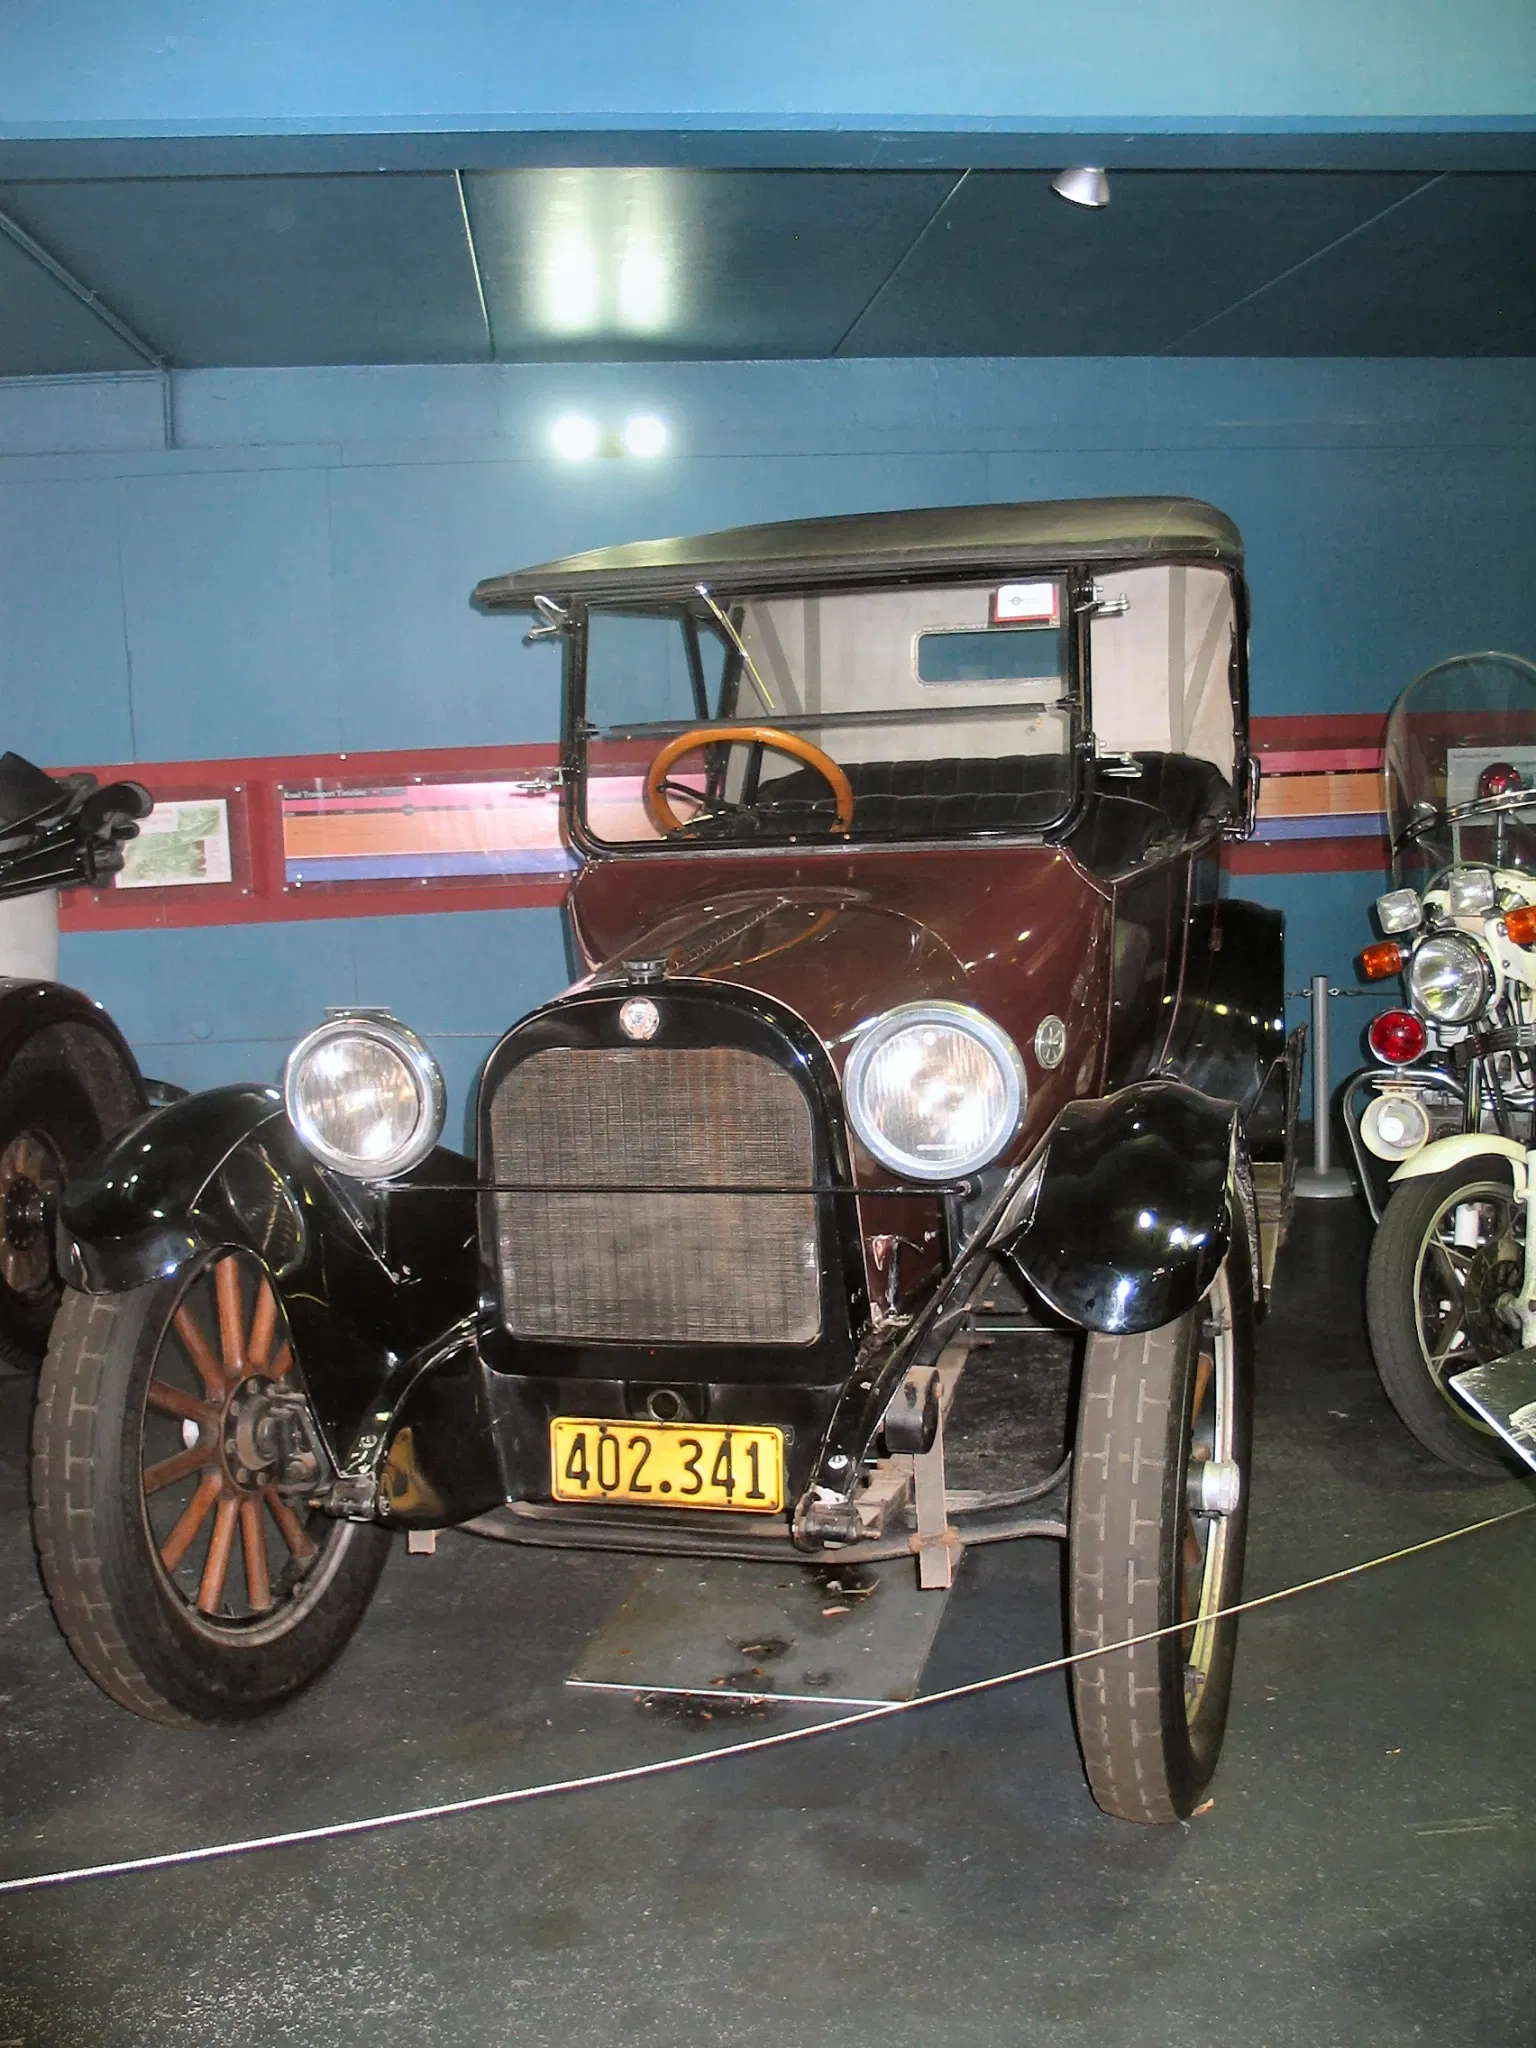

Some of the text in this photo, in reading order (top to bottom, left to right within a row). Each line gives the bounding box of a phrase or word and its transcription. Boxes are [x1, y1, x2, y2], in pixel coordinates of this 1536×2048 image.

[284, 791, 302, 799] Road
[303, 790, 336, 799] Transport
[565, 1433, 766, 1500] 402.341
